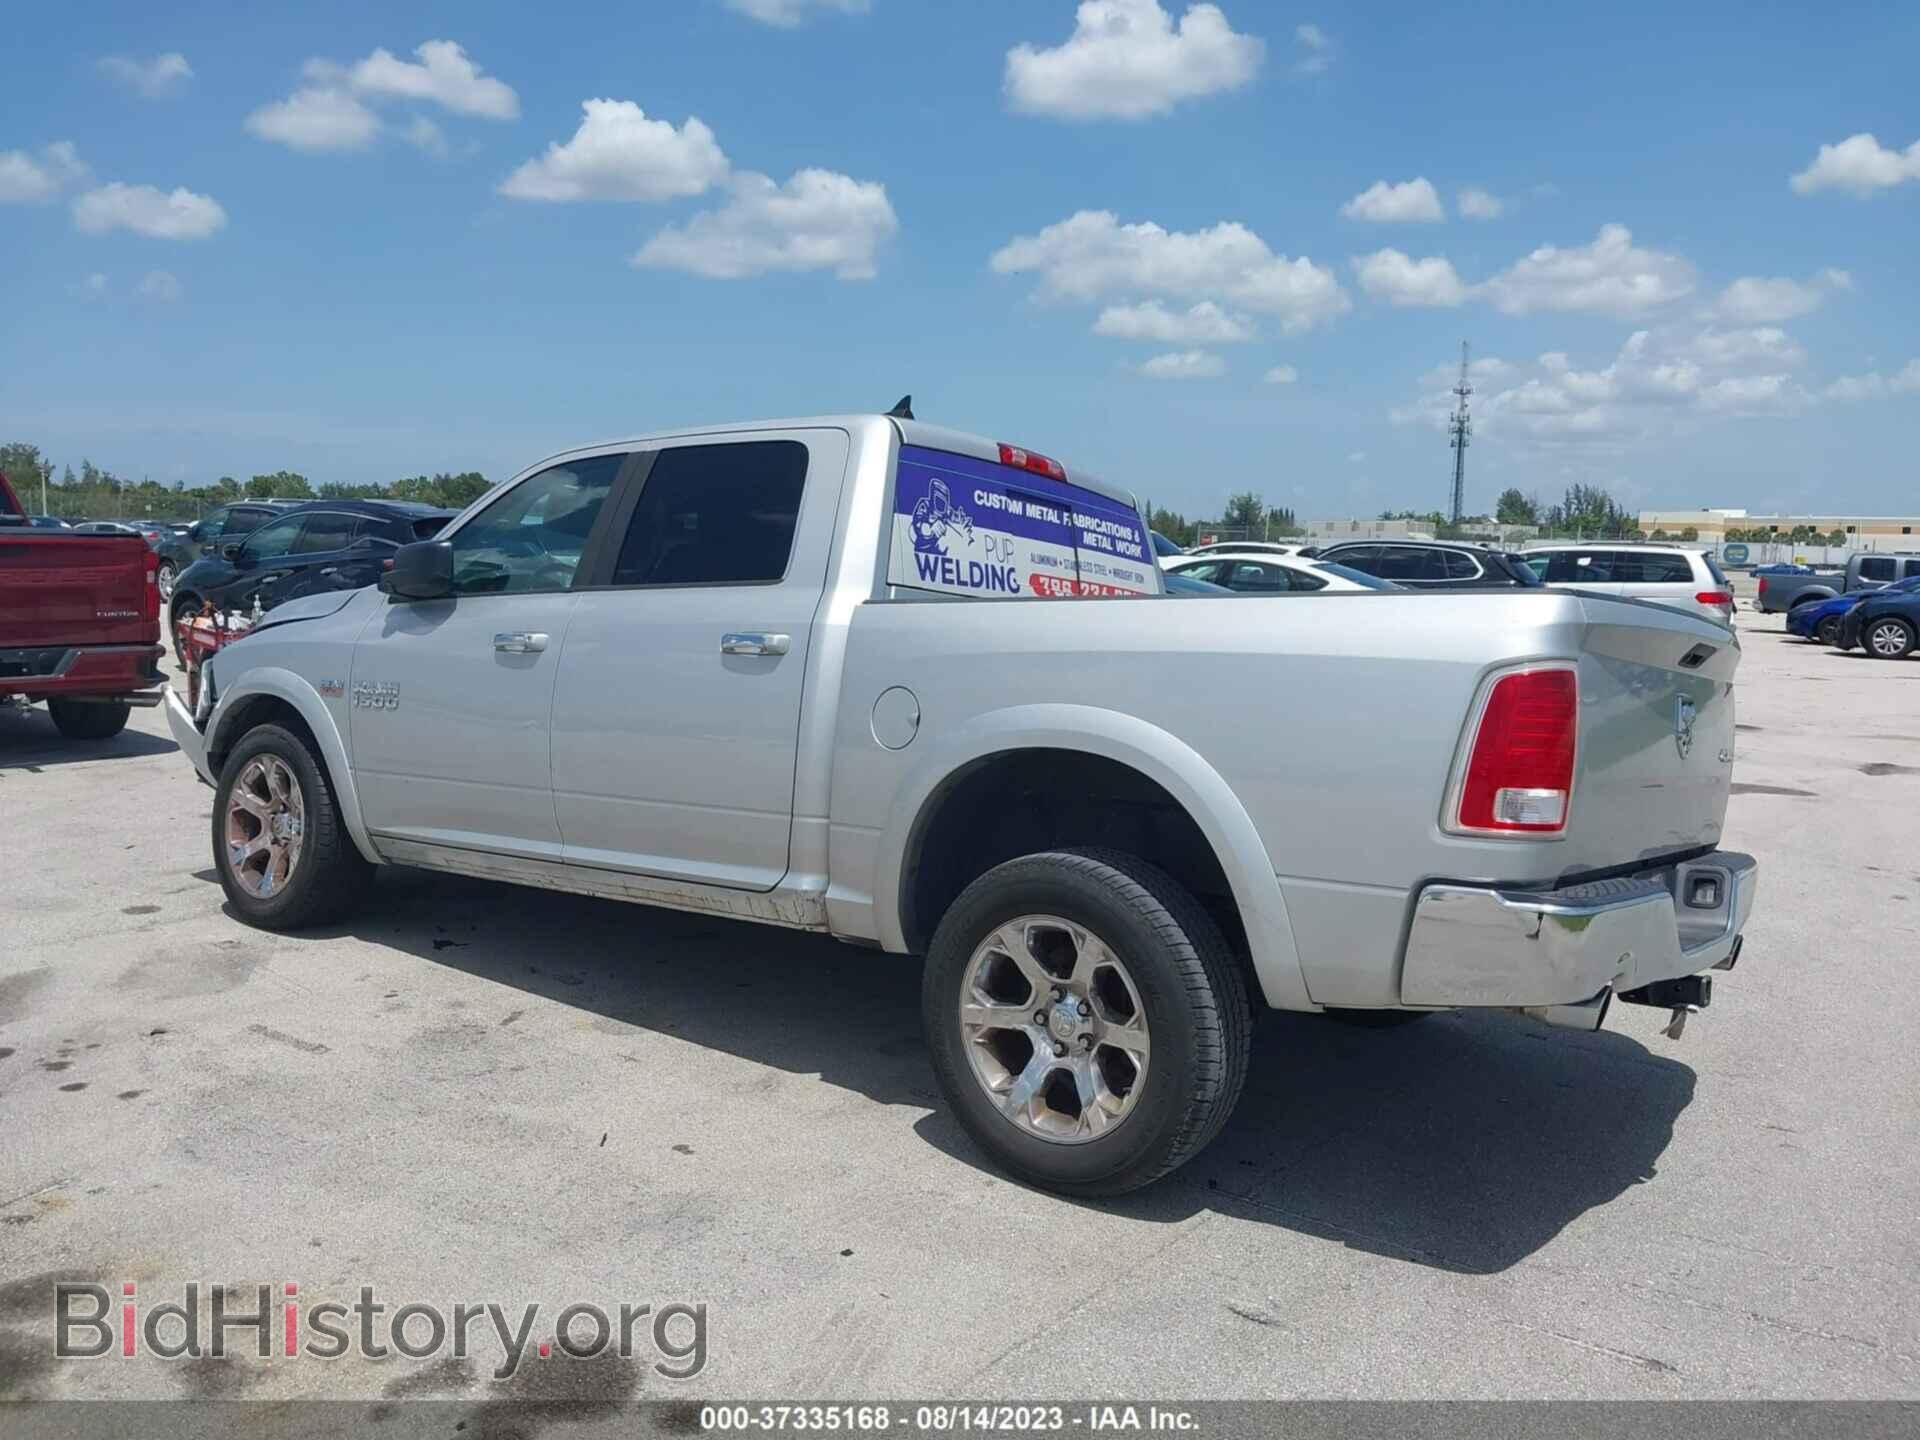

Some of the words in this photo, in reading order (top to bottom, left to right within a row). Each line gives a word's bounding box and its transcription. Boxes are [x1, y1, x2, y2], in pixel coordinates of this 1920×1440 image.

[974, 490, 1022, 515] CUSTOM
[1026, 503, 1060, 524] METAL
[1063, 512, 1132, 540] FABRICATIONS
[984, 534, 1014, 563] PUP
[1083, 531, 1112, 551] METAL
[1115, 539, 1142, 558] WORK
[915, 553, 1020, 594] WELDING
